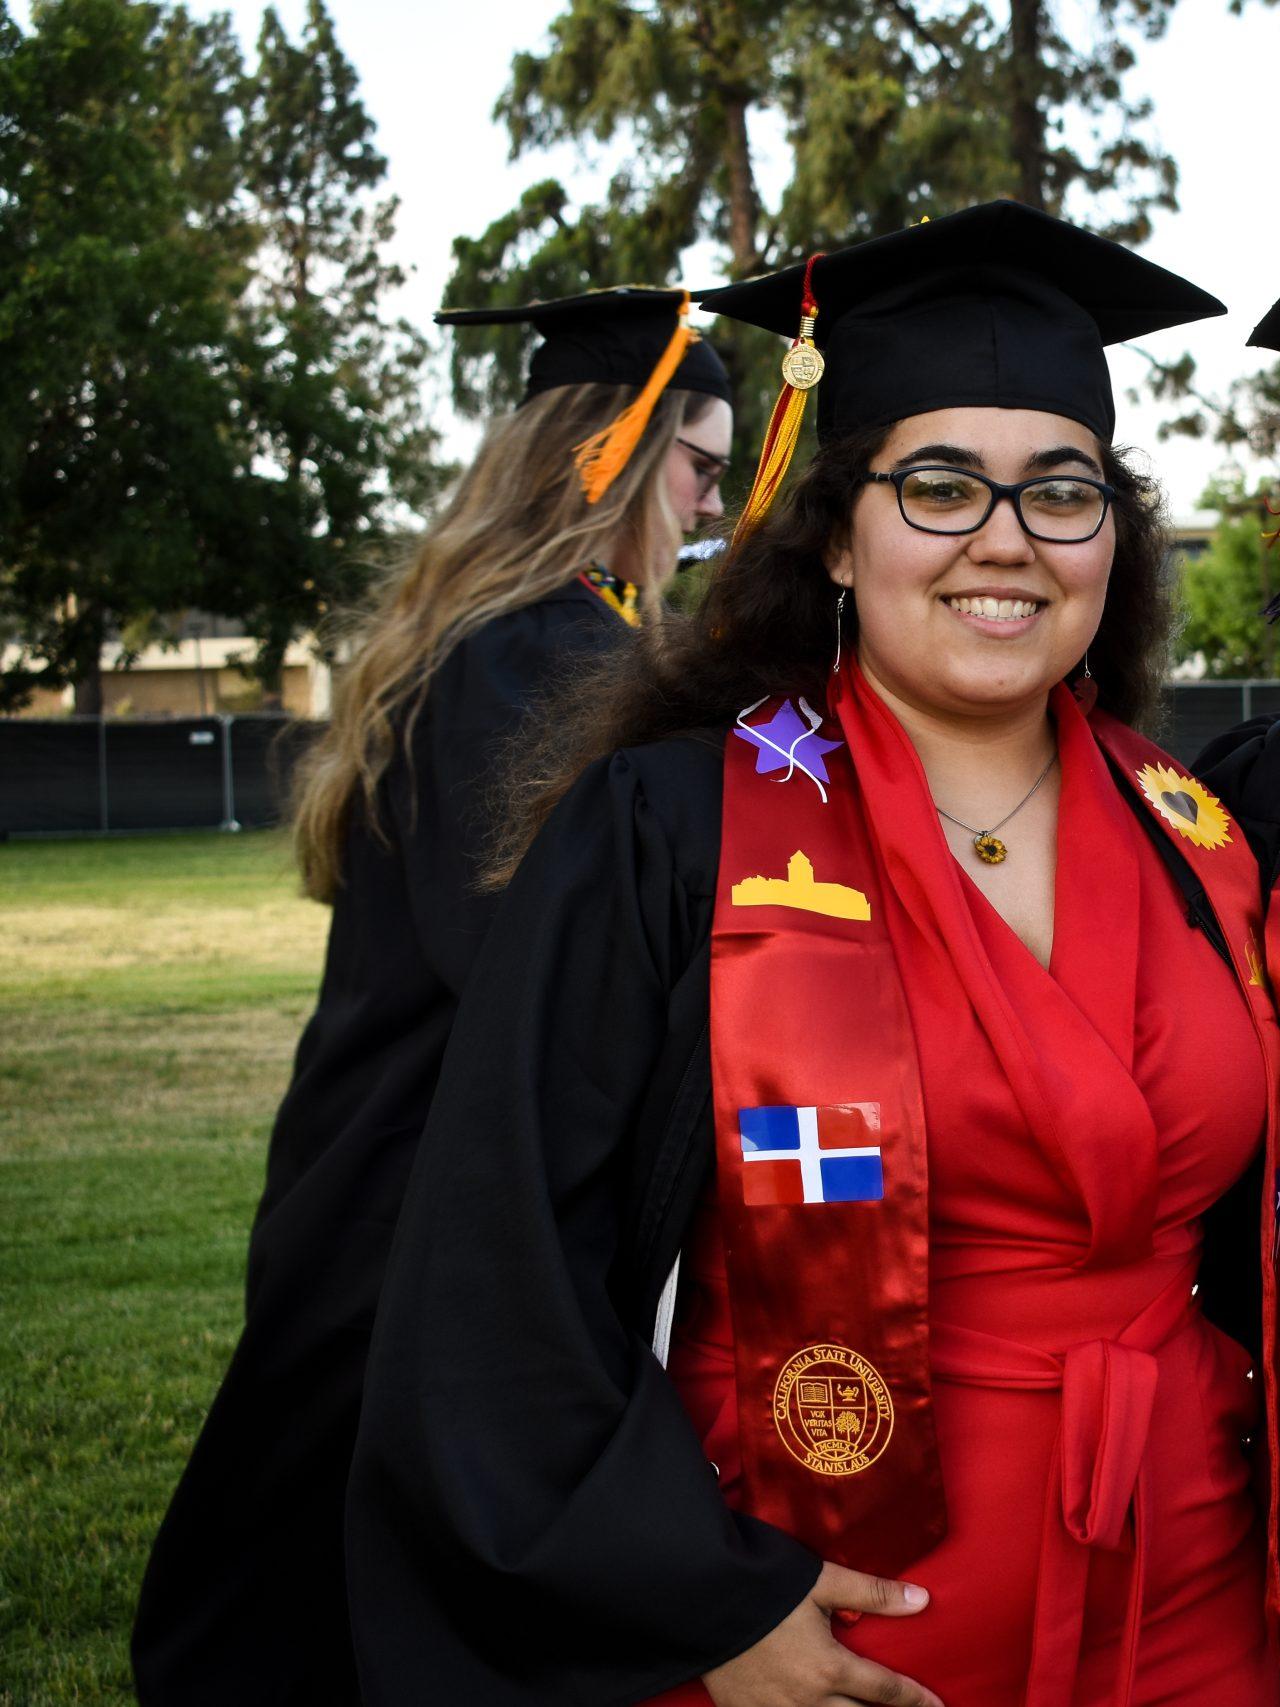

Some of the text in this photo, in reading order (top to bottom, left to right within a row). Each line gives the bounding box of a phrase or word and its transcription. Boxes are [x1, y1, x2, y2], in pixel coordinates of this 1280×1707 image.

[777, 1348, 890, 1420] CALIFORNIA STATE UNIVERSITY
[810, 1410, 826, 1419] VOX
[804, 1419, 832, 1428] VERITAS
[811, 1429, 828, 1437] VITA
[819, 1441, 851, 1451] MCMLX
[804, 1453, 870, 1473] STANISLAUS
